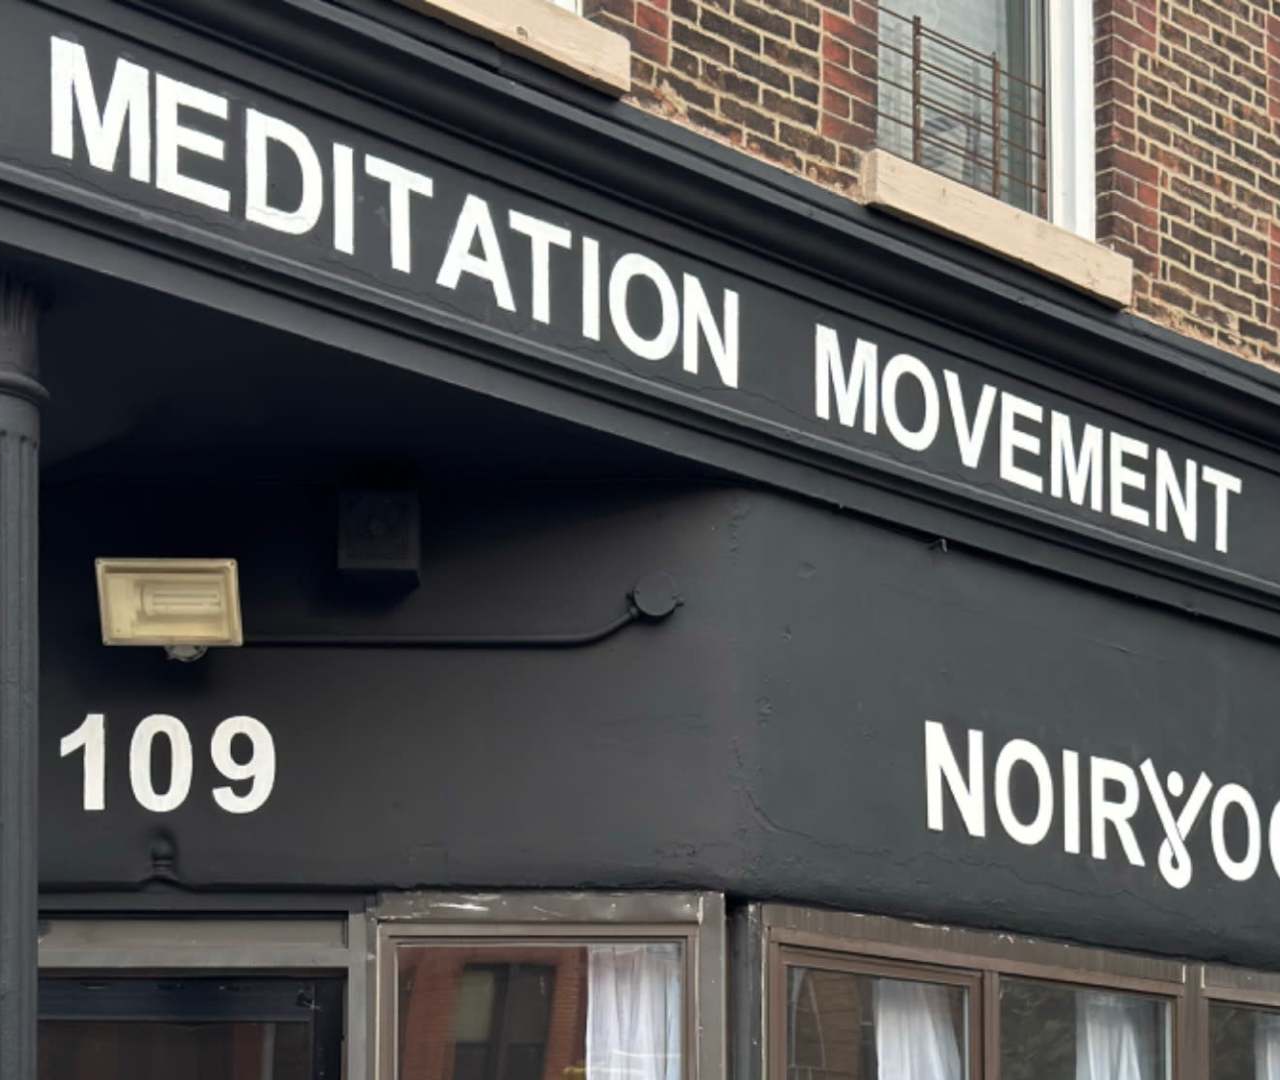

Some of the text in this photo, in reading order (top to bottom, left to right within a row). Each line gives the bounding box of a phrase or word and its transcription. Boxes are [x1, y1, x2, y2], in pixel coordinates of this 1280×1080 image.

[50, 36, 1242, 554] MEDITATION MOVEMENT
[60, 713, 276, 814] 109
